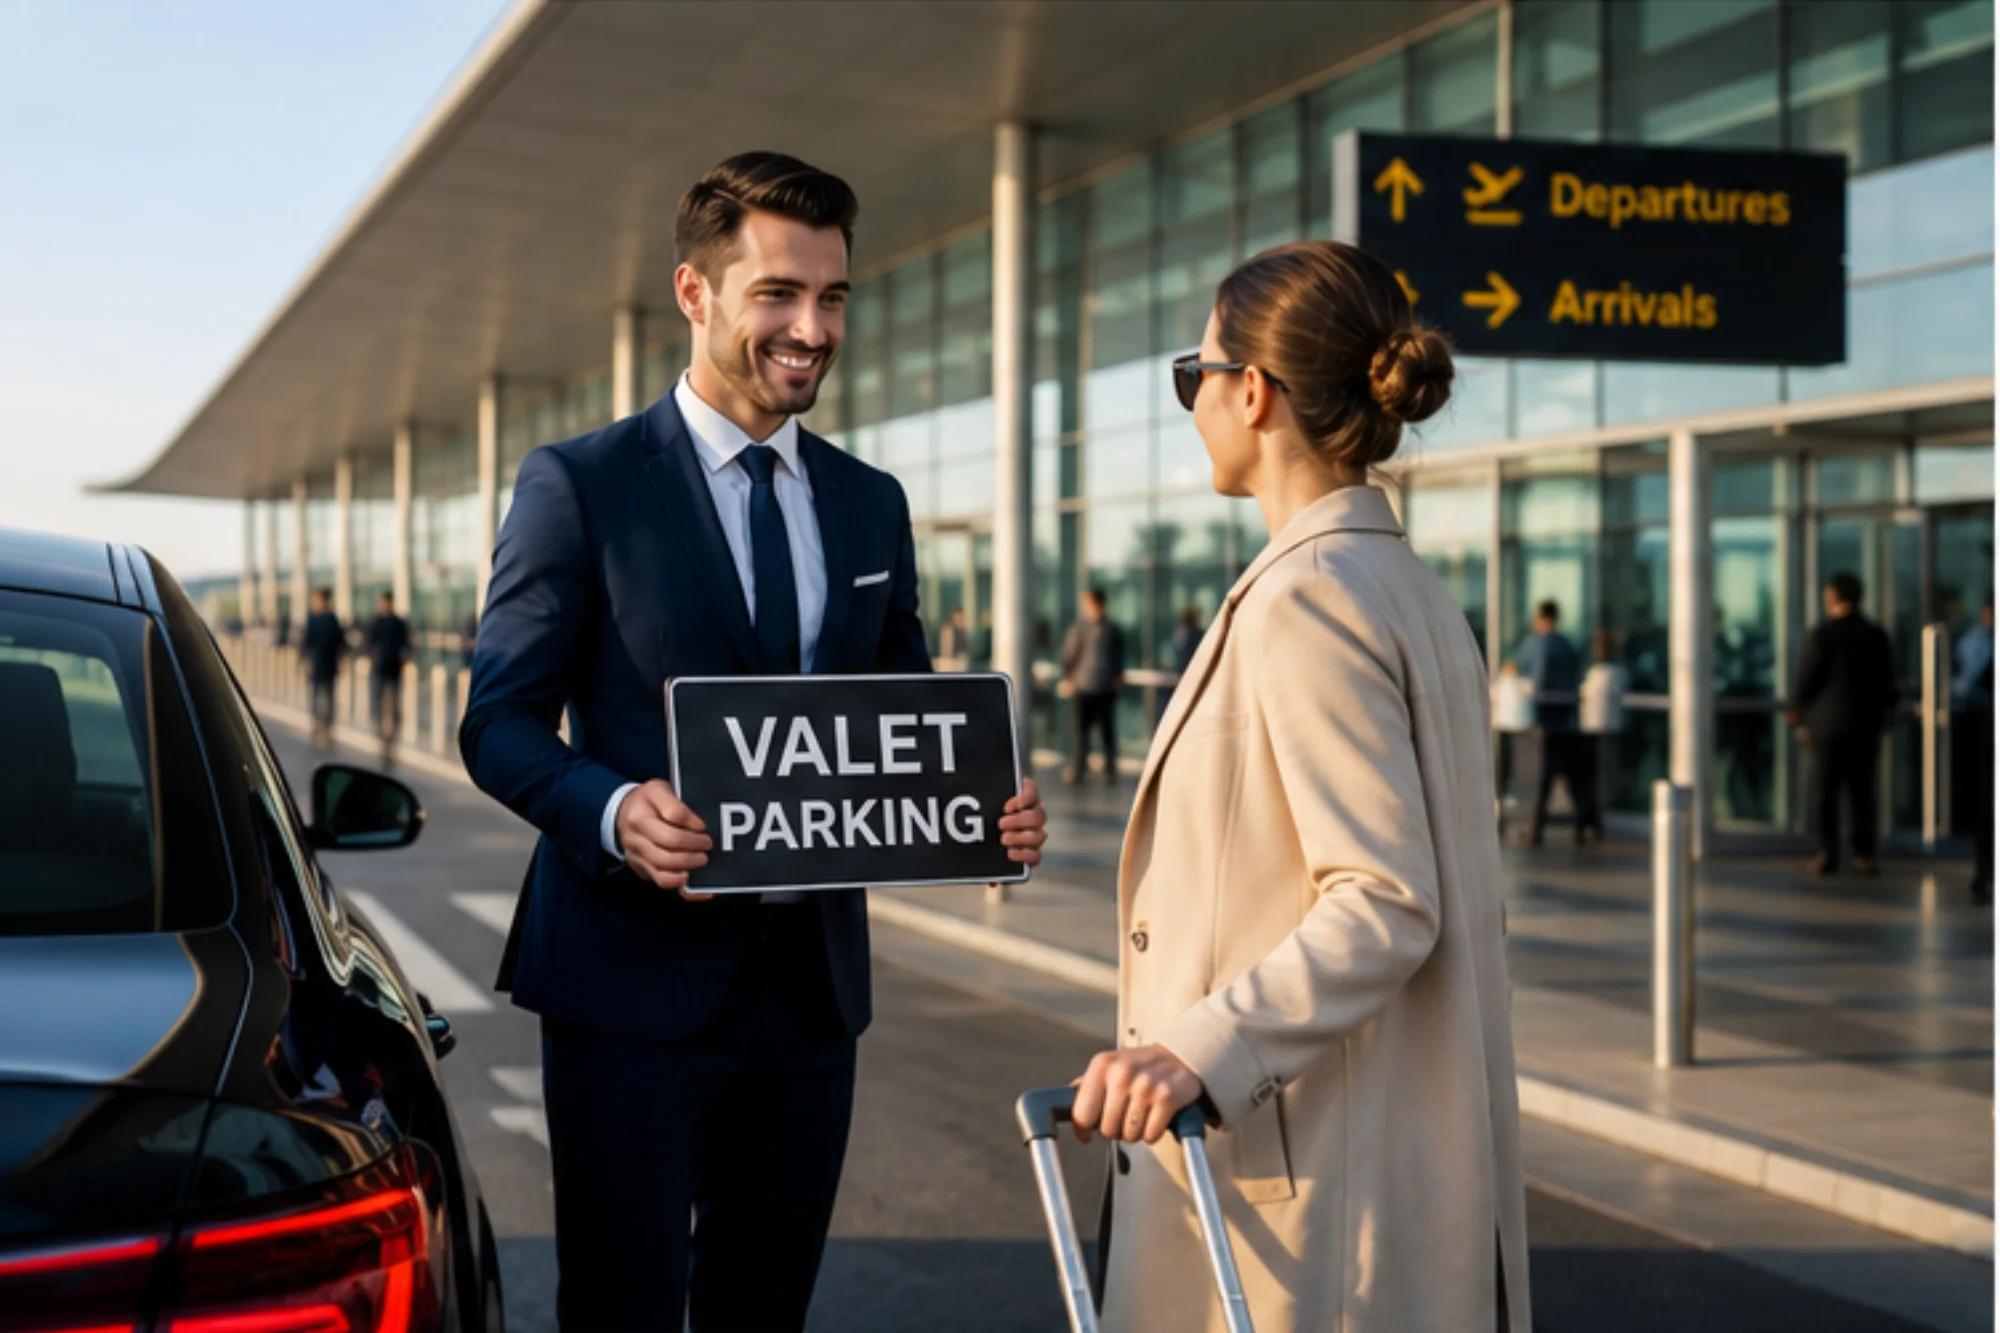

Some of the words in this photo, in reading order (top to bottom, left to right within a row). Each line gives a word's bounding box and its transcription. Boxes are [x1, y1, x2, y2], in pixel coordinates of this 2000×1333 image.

[1549, 172, 1791, 229] Departures
[1548, 279, 1718, 328] Arrivals
[723, 712, 968, 778] VALET
[720, 795, 985, 851] PARKING
